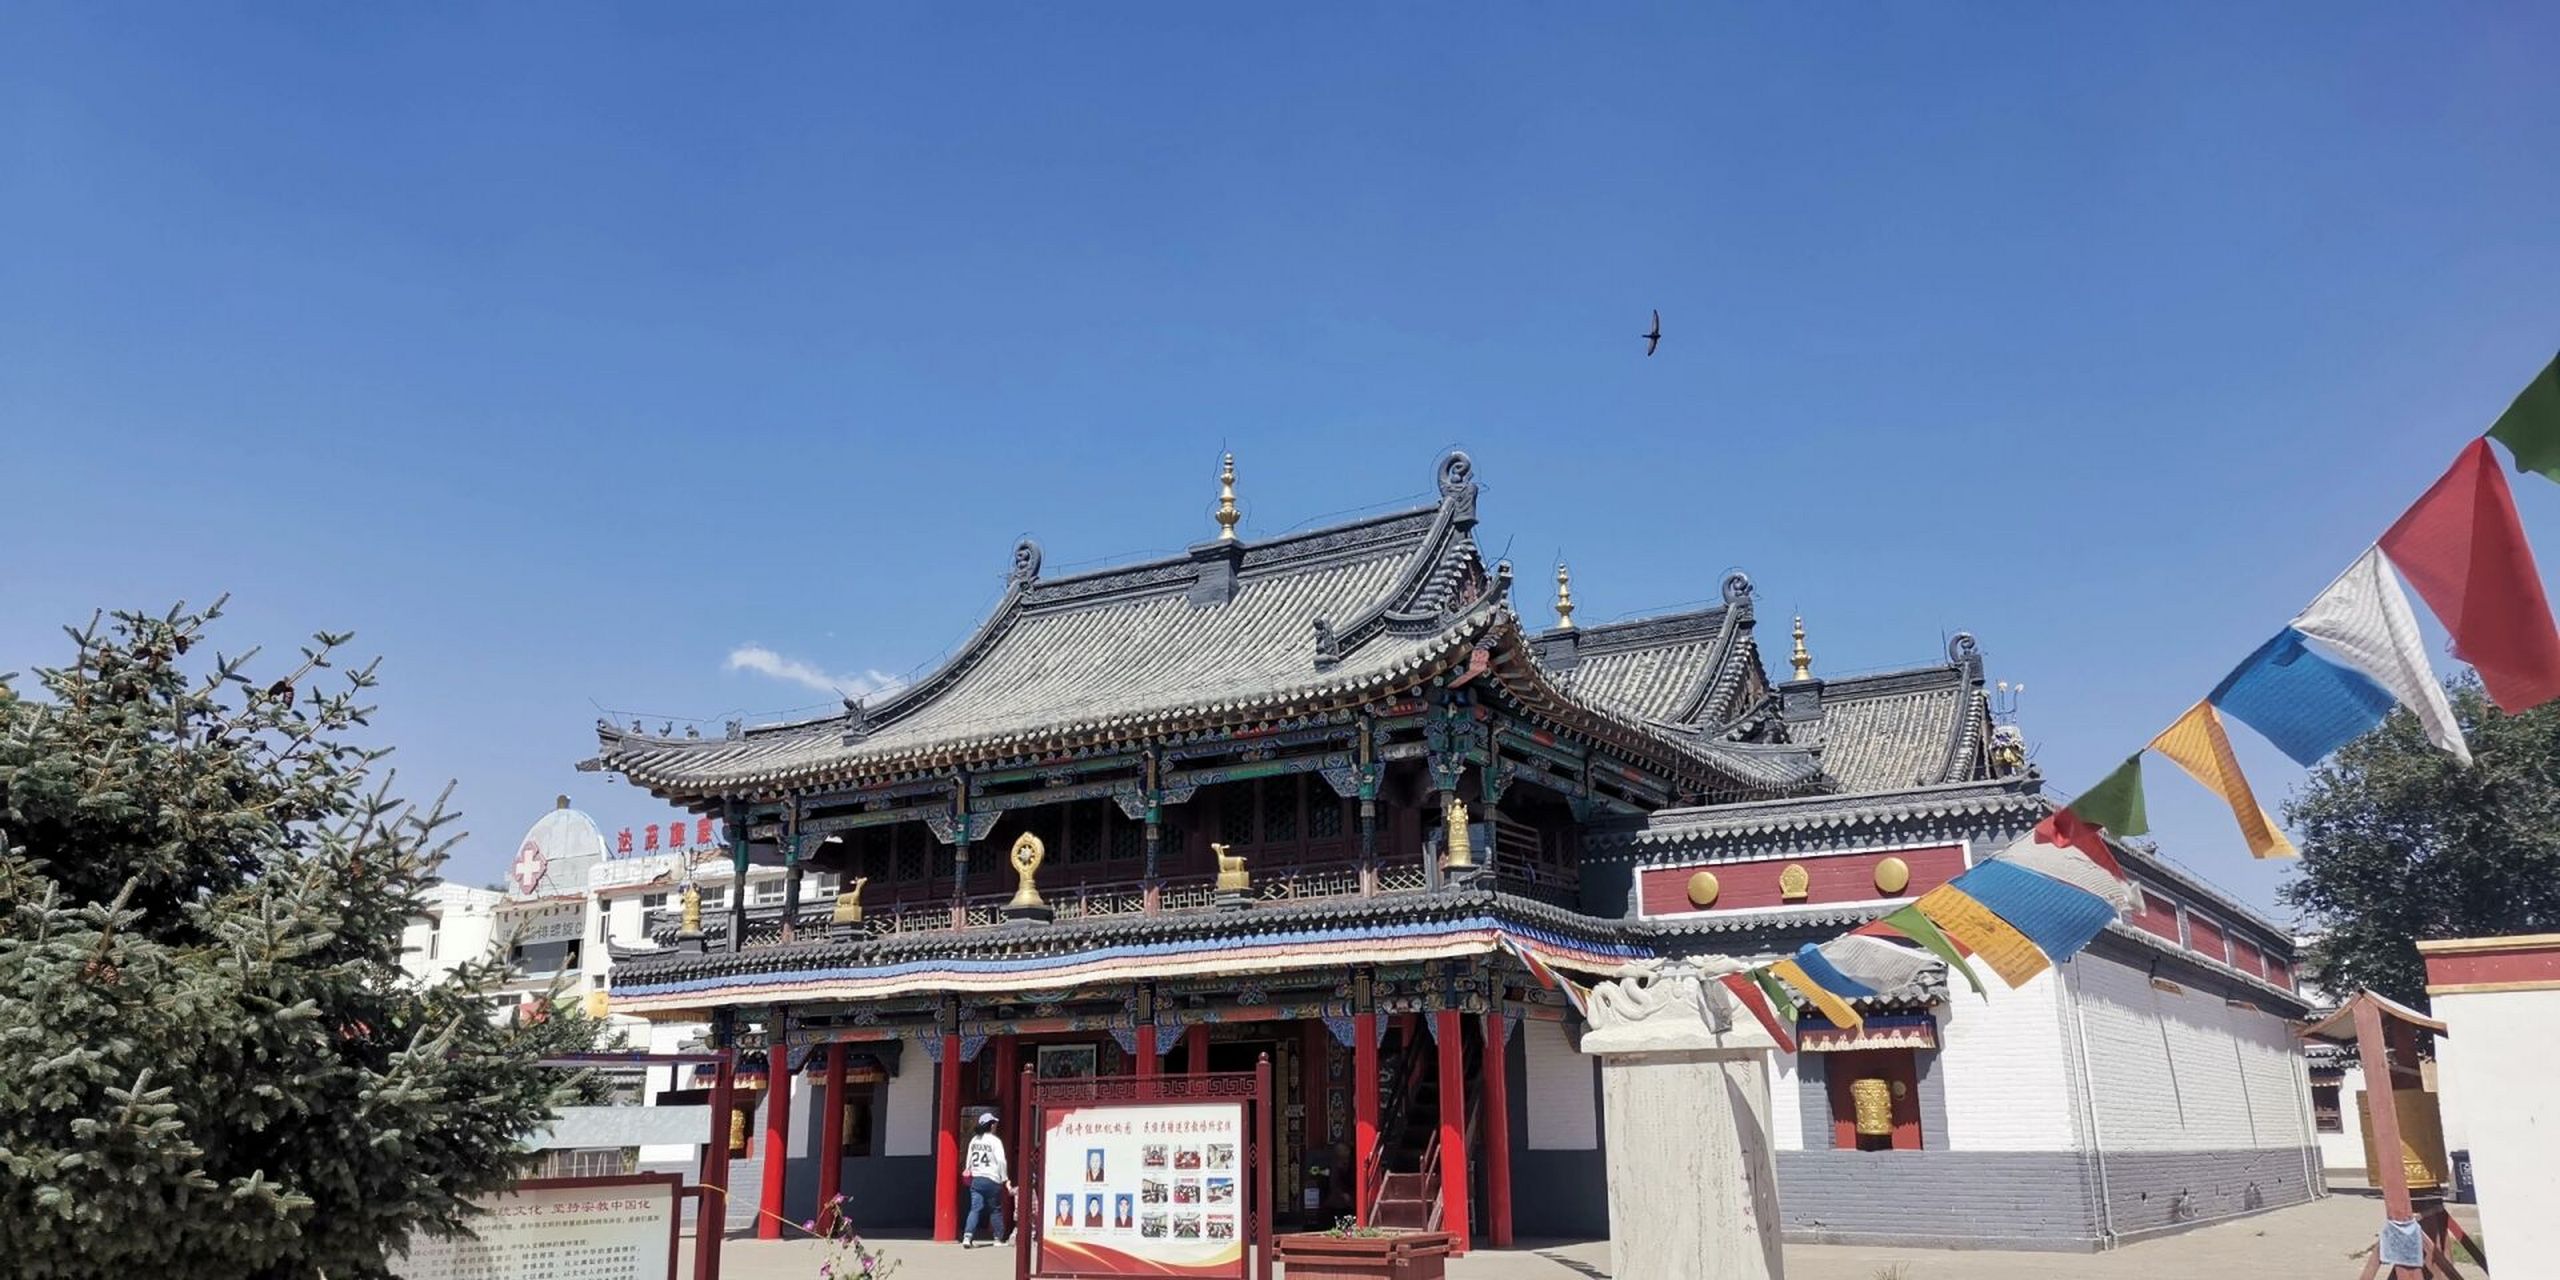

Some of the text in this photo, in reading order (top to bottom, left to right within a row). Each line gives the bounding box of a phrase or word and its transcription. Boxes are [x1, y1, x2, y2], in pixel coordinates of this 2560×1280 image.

[972, 1151, 991, 1167] 24
[551, 1200, 651, 1215] 坚持宗教中国化
